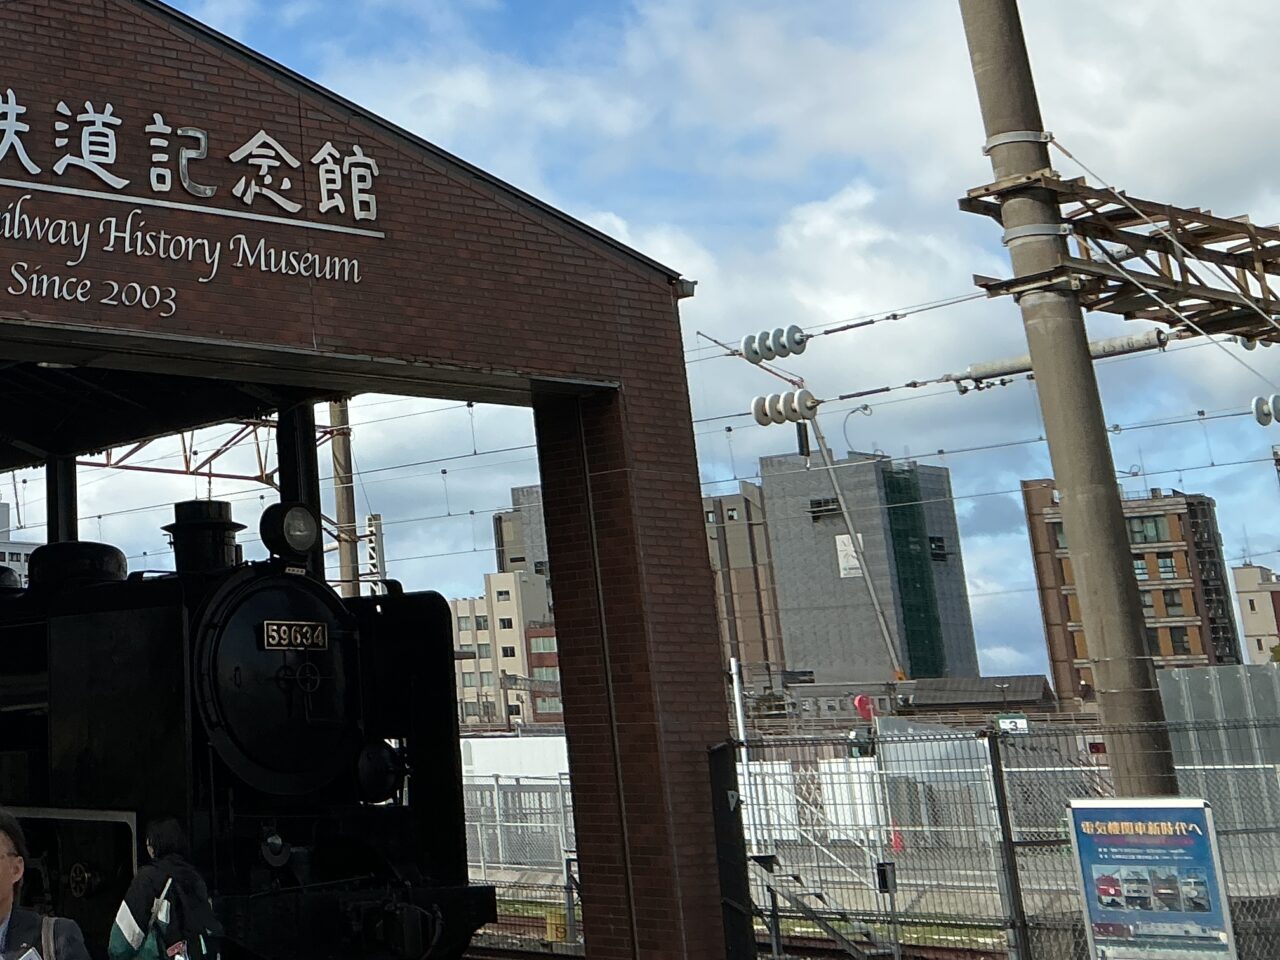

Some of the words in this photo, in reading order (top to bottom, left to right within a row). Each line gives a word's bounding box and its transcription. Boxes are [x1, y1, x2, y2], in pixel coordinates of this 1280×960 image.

[99, 216, 221, 283] History
[229, 233, 362, 284] Museum
[7, 262, 91, 303] Since
[99, 280, 177, 317] 2003
[268, 626, 324, 645] 59634
